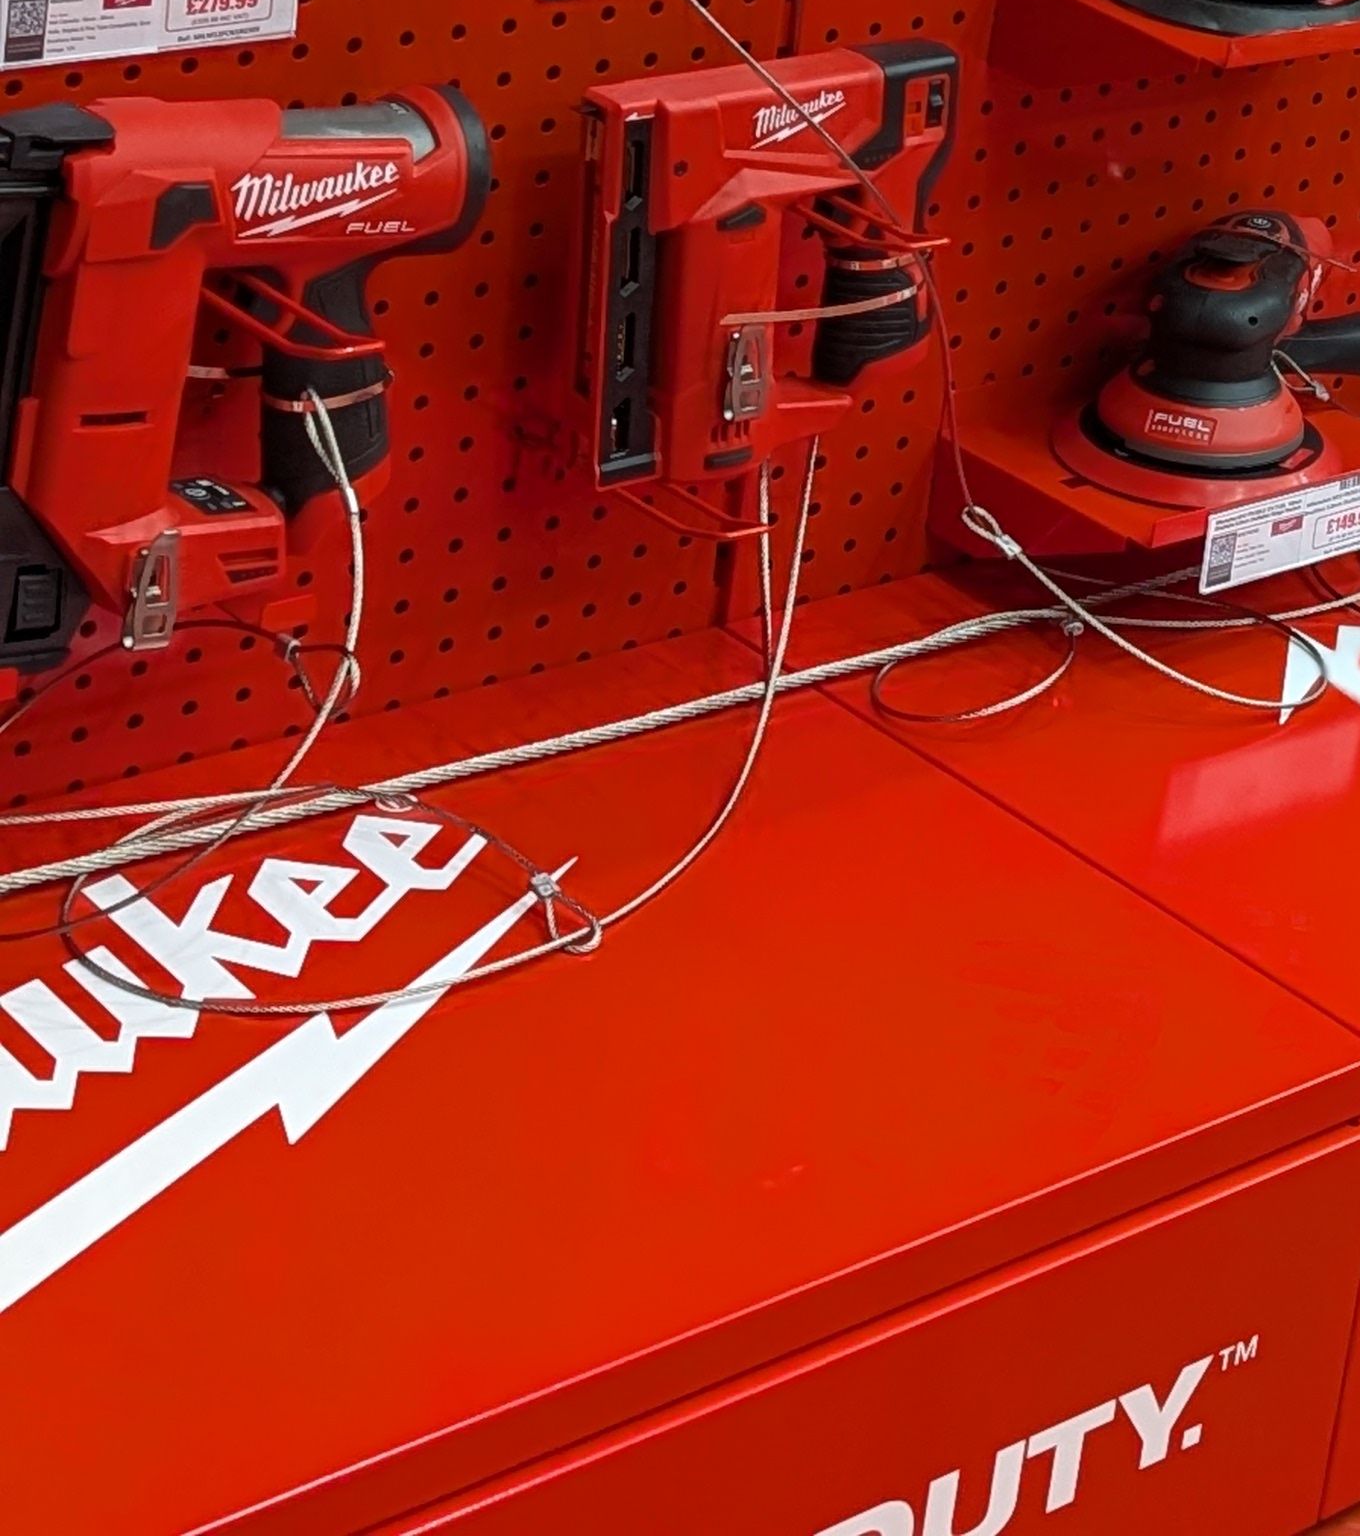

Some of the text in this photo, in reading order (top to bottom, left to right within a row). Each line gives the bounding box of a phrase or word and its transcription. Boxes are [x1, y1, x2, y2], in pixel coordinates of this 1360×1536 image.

[230, 161, 400, 221] Milwaukee
[346, 220, 416, 234] FUEL
[1153, 413, 1211, 433] FUEL
